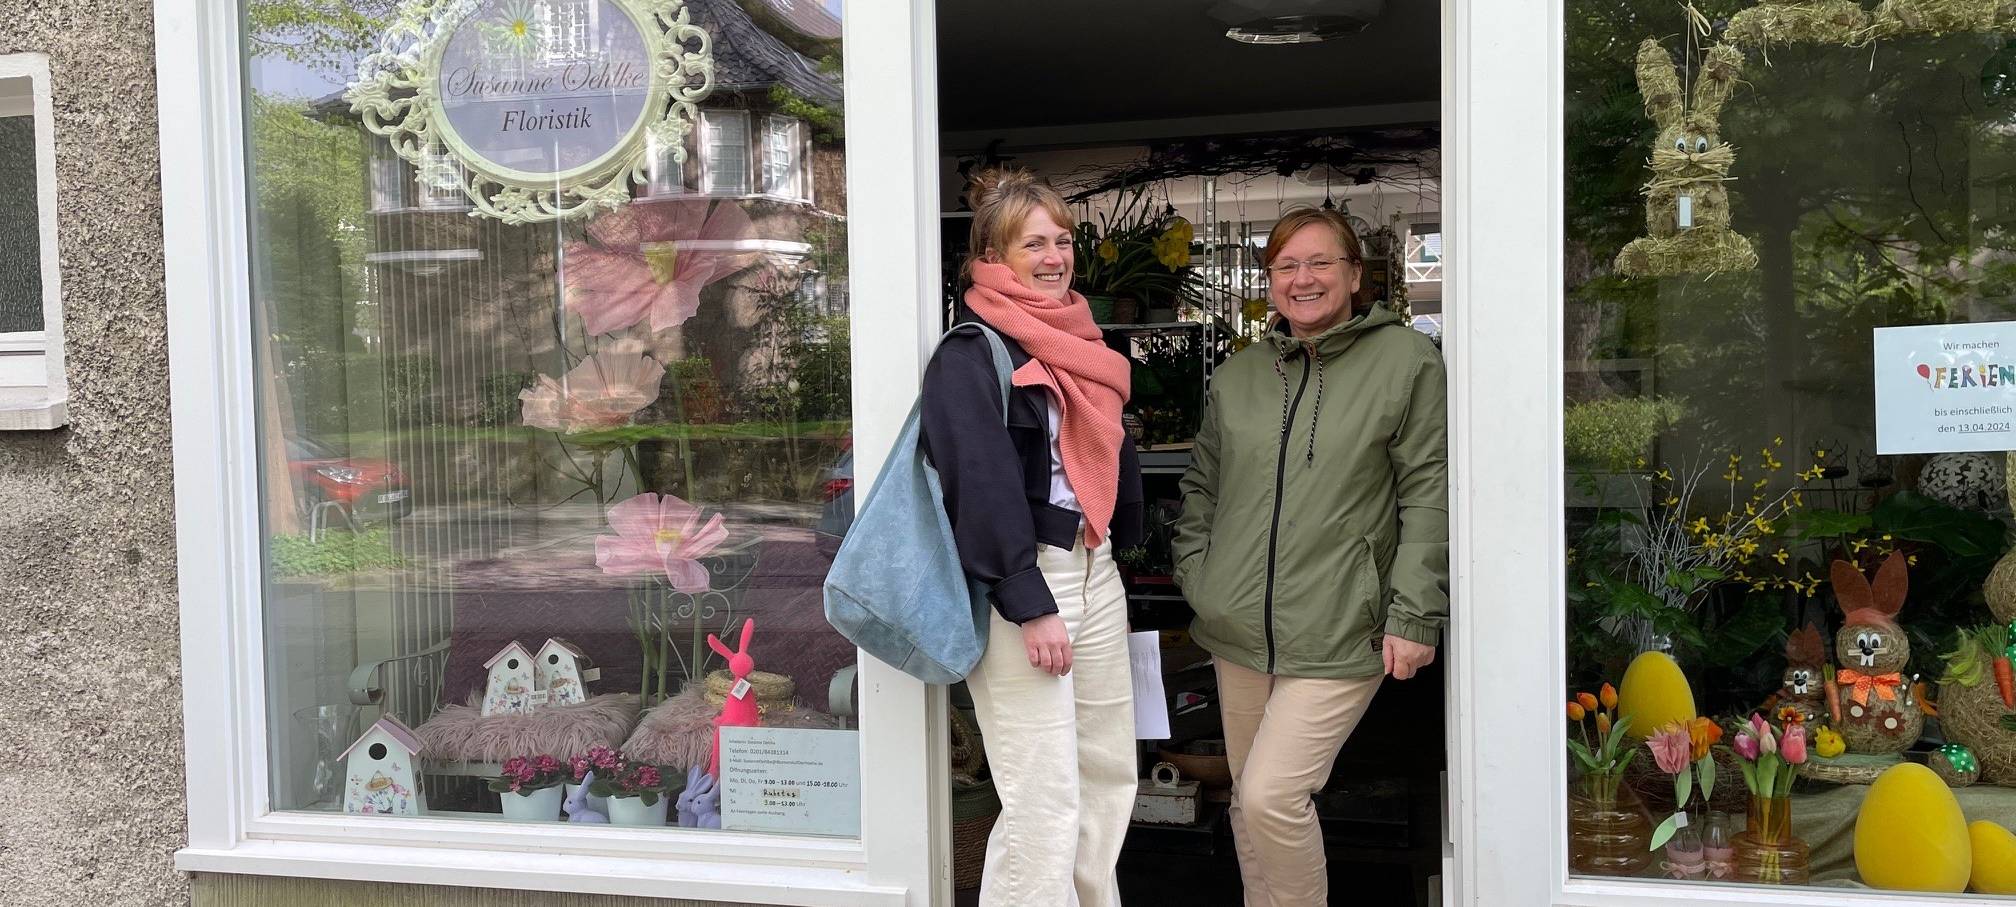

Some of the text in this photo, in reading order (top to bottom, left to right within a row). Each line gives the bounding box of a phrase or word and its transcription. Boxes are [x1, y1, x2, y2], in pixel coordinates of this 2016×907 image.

[447, 61, 644, 97] Susanne Oehlke
[502, 107, 592, 132] Floristik
[1943, 340, 2000, 351] Wir machen
[1934, 363, 2016, 389] FERIEN
[1934, 405, 2013, 417] bis einschließlich
[1938, 421, 2011, 434] den 13.04.2024
